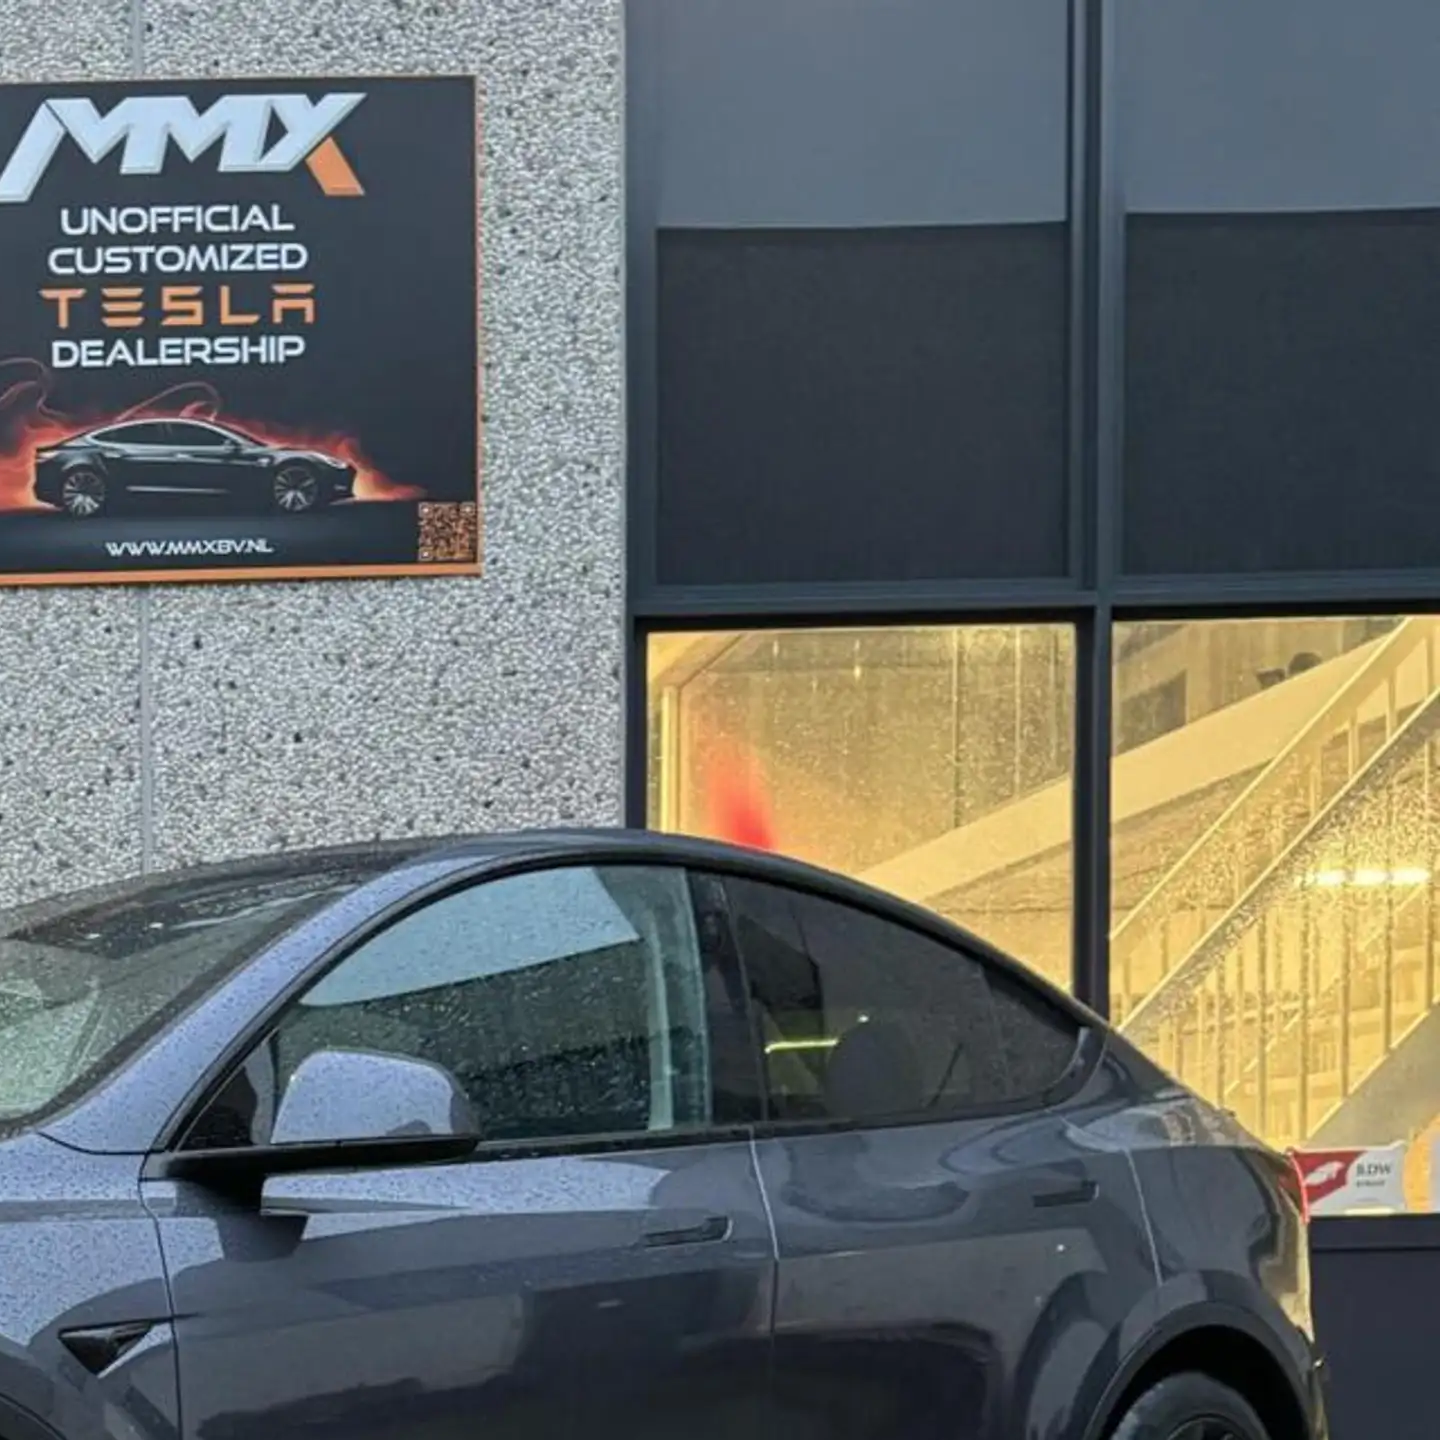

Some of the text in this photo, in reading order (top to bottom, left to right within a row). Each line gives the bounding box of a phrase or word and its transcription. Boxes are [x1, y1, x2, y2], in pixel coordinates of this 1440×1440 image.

[60, 204, 295, 235] UNOFFICIAL
[48, 242, 308, 274] CUSTOMIZED
[39, 283, 315, 328] TESLA
[51, 335, 306, 368] DEALERSHIP
[105, 538, 273, 557] WWW.MMXBV.NL
